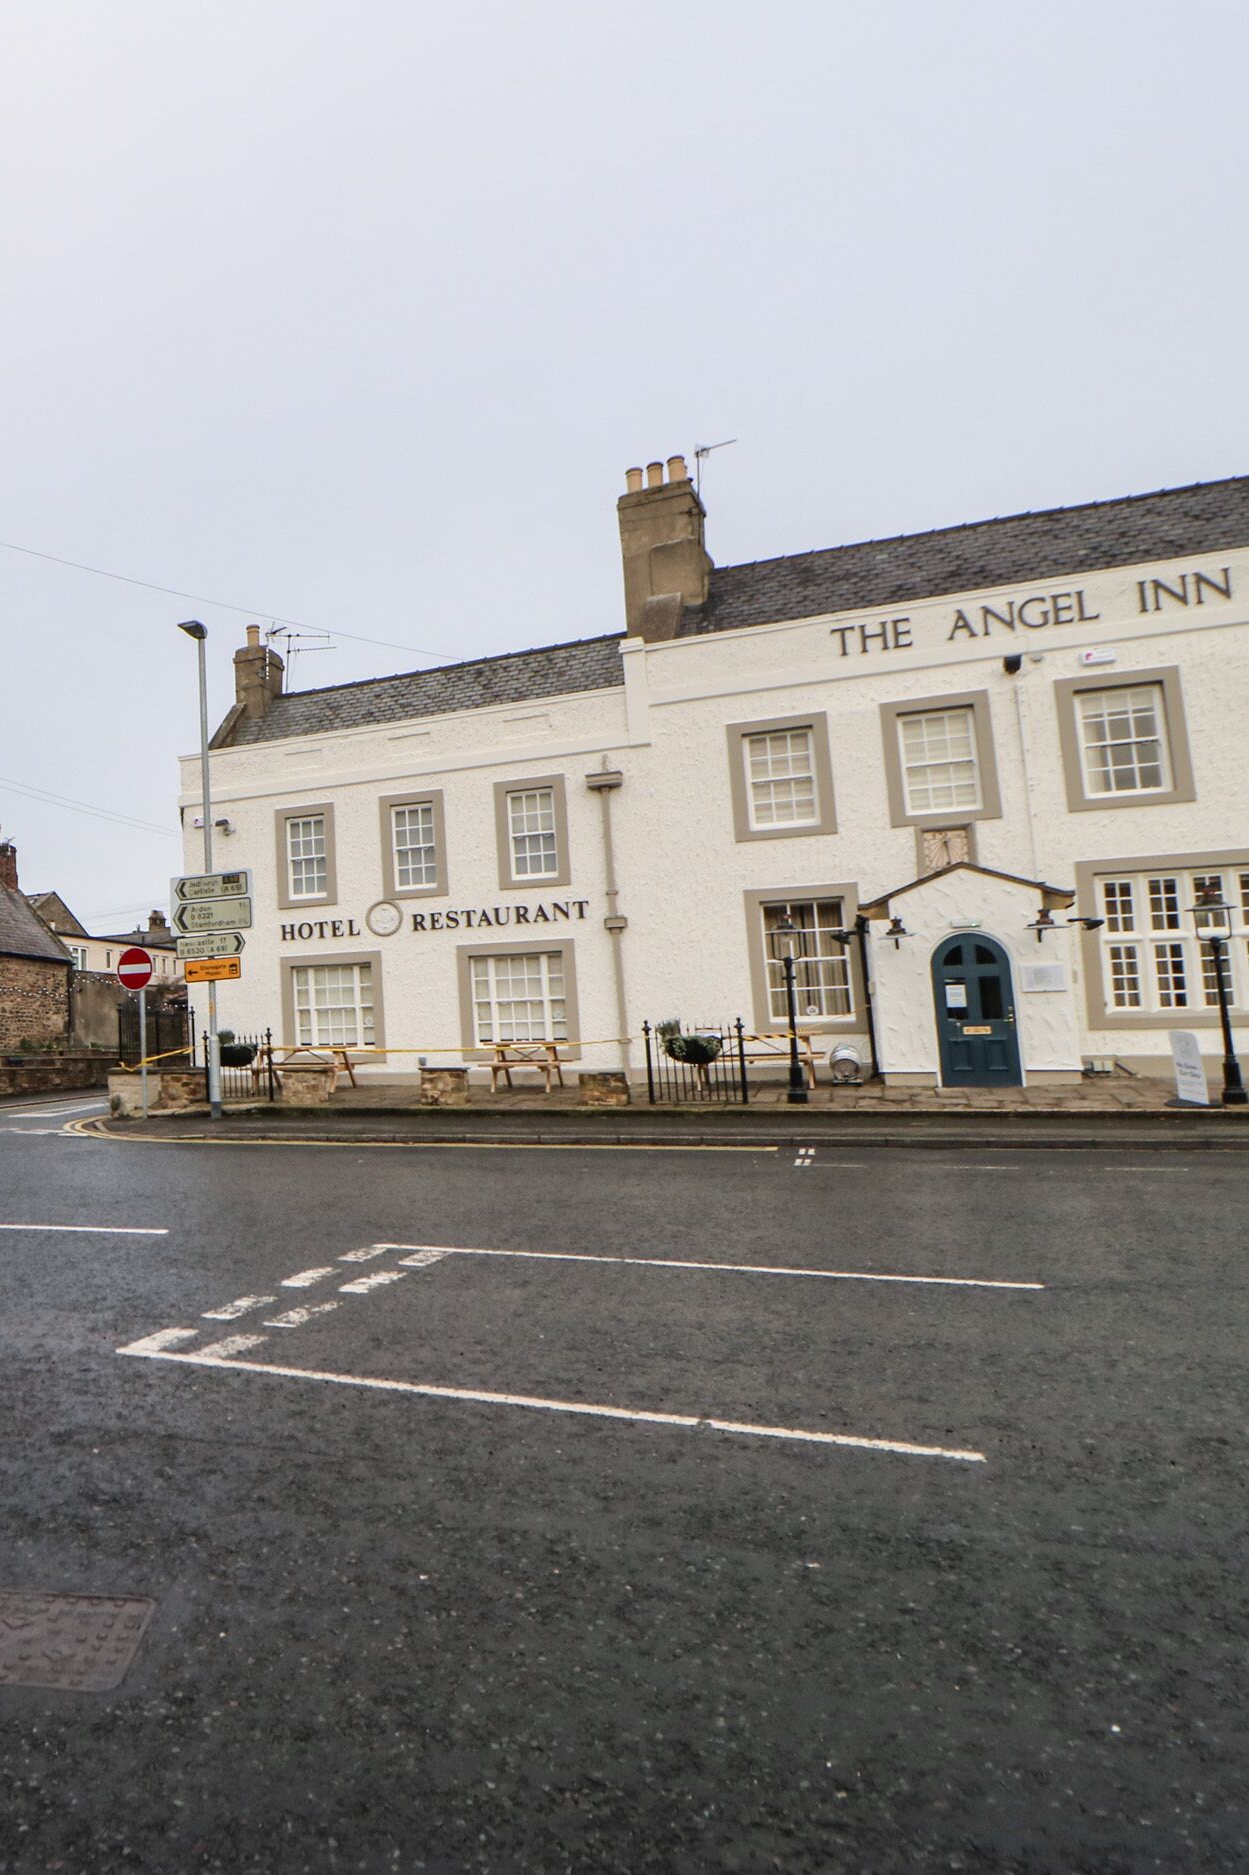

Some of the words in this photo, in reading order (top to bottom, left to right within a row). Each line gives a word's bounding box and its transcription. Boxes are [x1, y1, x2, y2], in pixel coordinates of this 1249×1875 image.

[830, 617, 913, 656] THE
[948, 590, 1101, 641] ANGEL
[1136, 566, 1232, 614] INN
[281, 919, 361, 941] HOTEL
[412, 900, 589, 932] RESTAURANT
